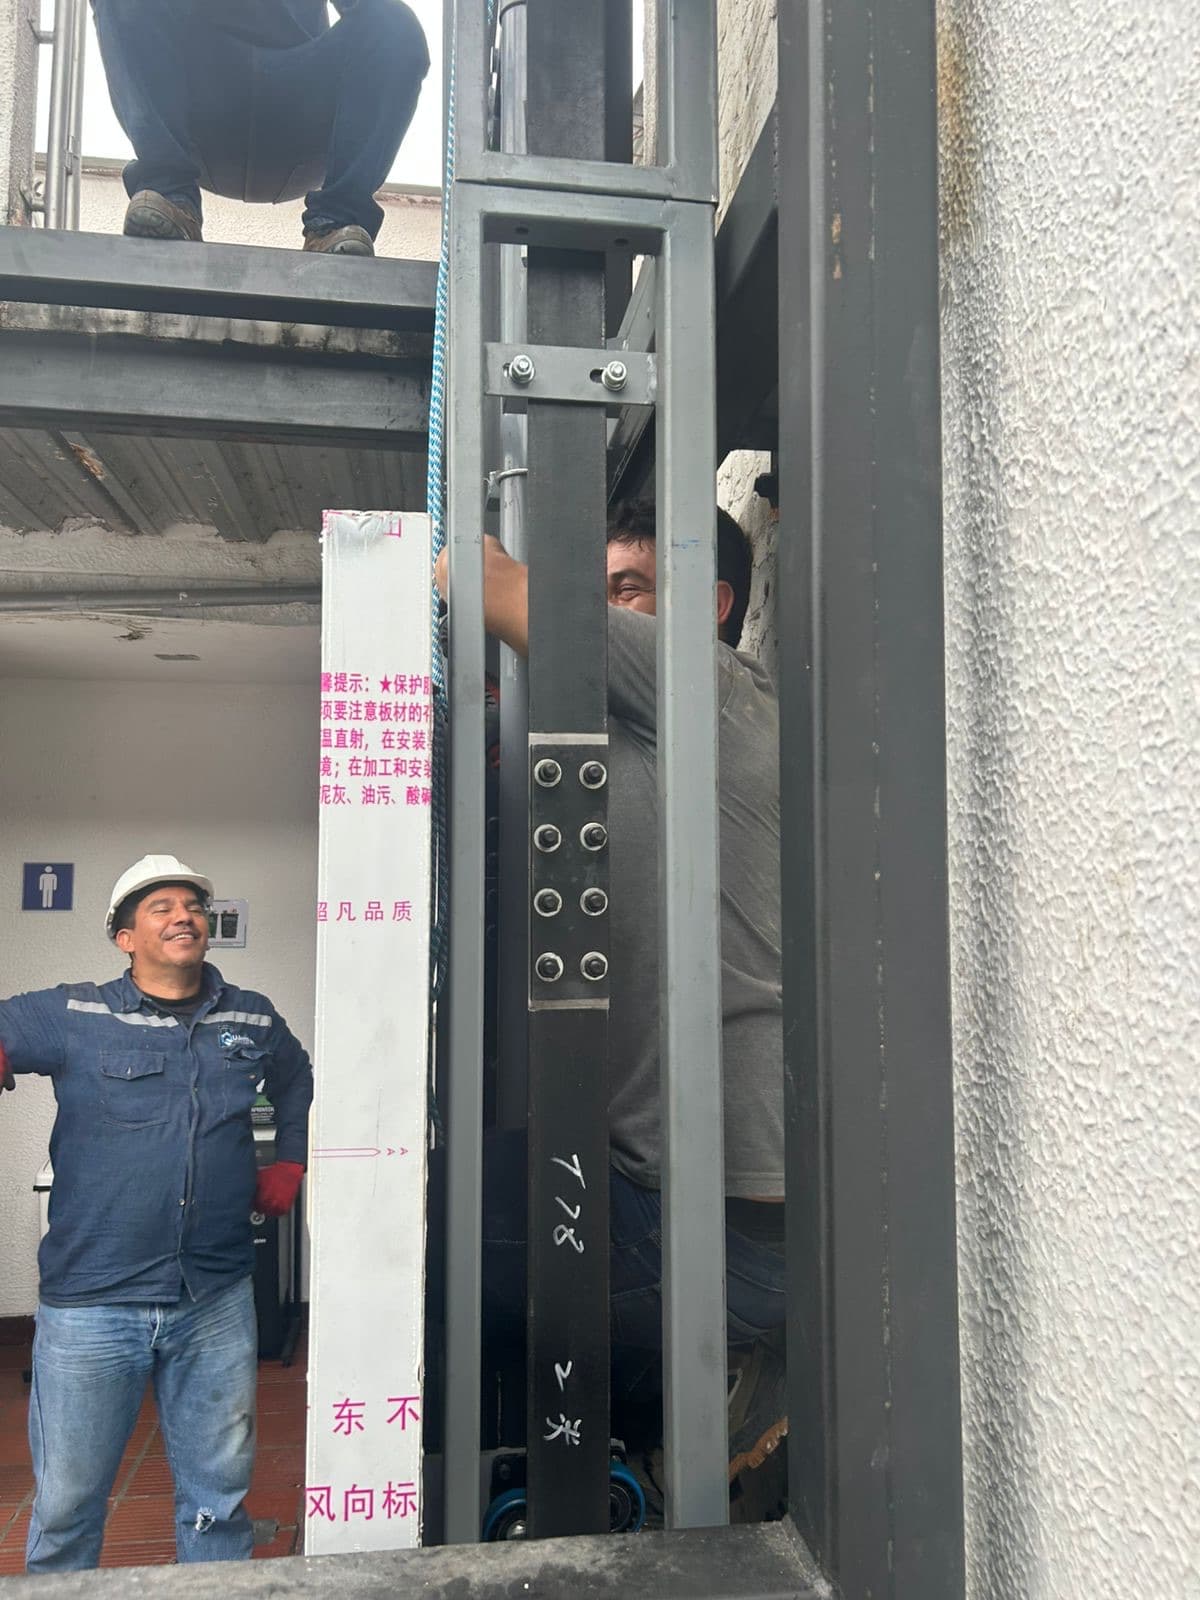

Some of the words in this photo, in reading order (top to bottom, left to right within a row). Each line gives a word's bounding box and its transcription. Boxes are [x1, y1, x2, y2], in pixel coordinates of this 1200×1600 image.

[320, 728, 431, 751] 温直射，在安装
[305, 1481, 418, 1522] 风向标
